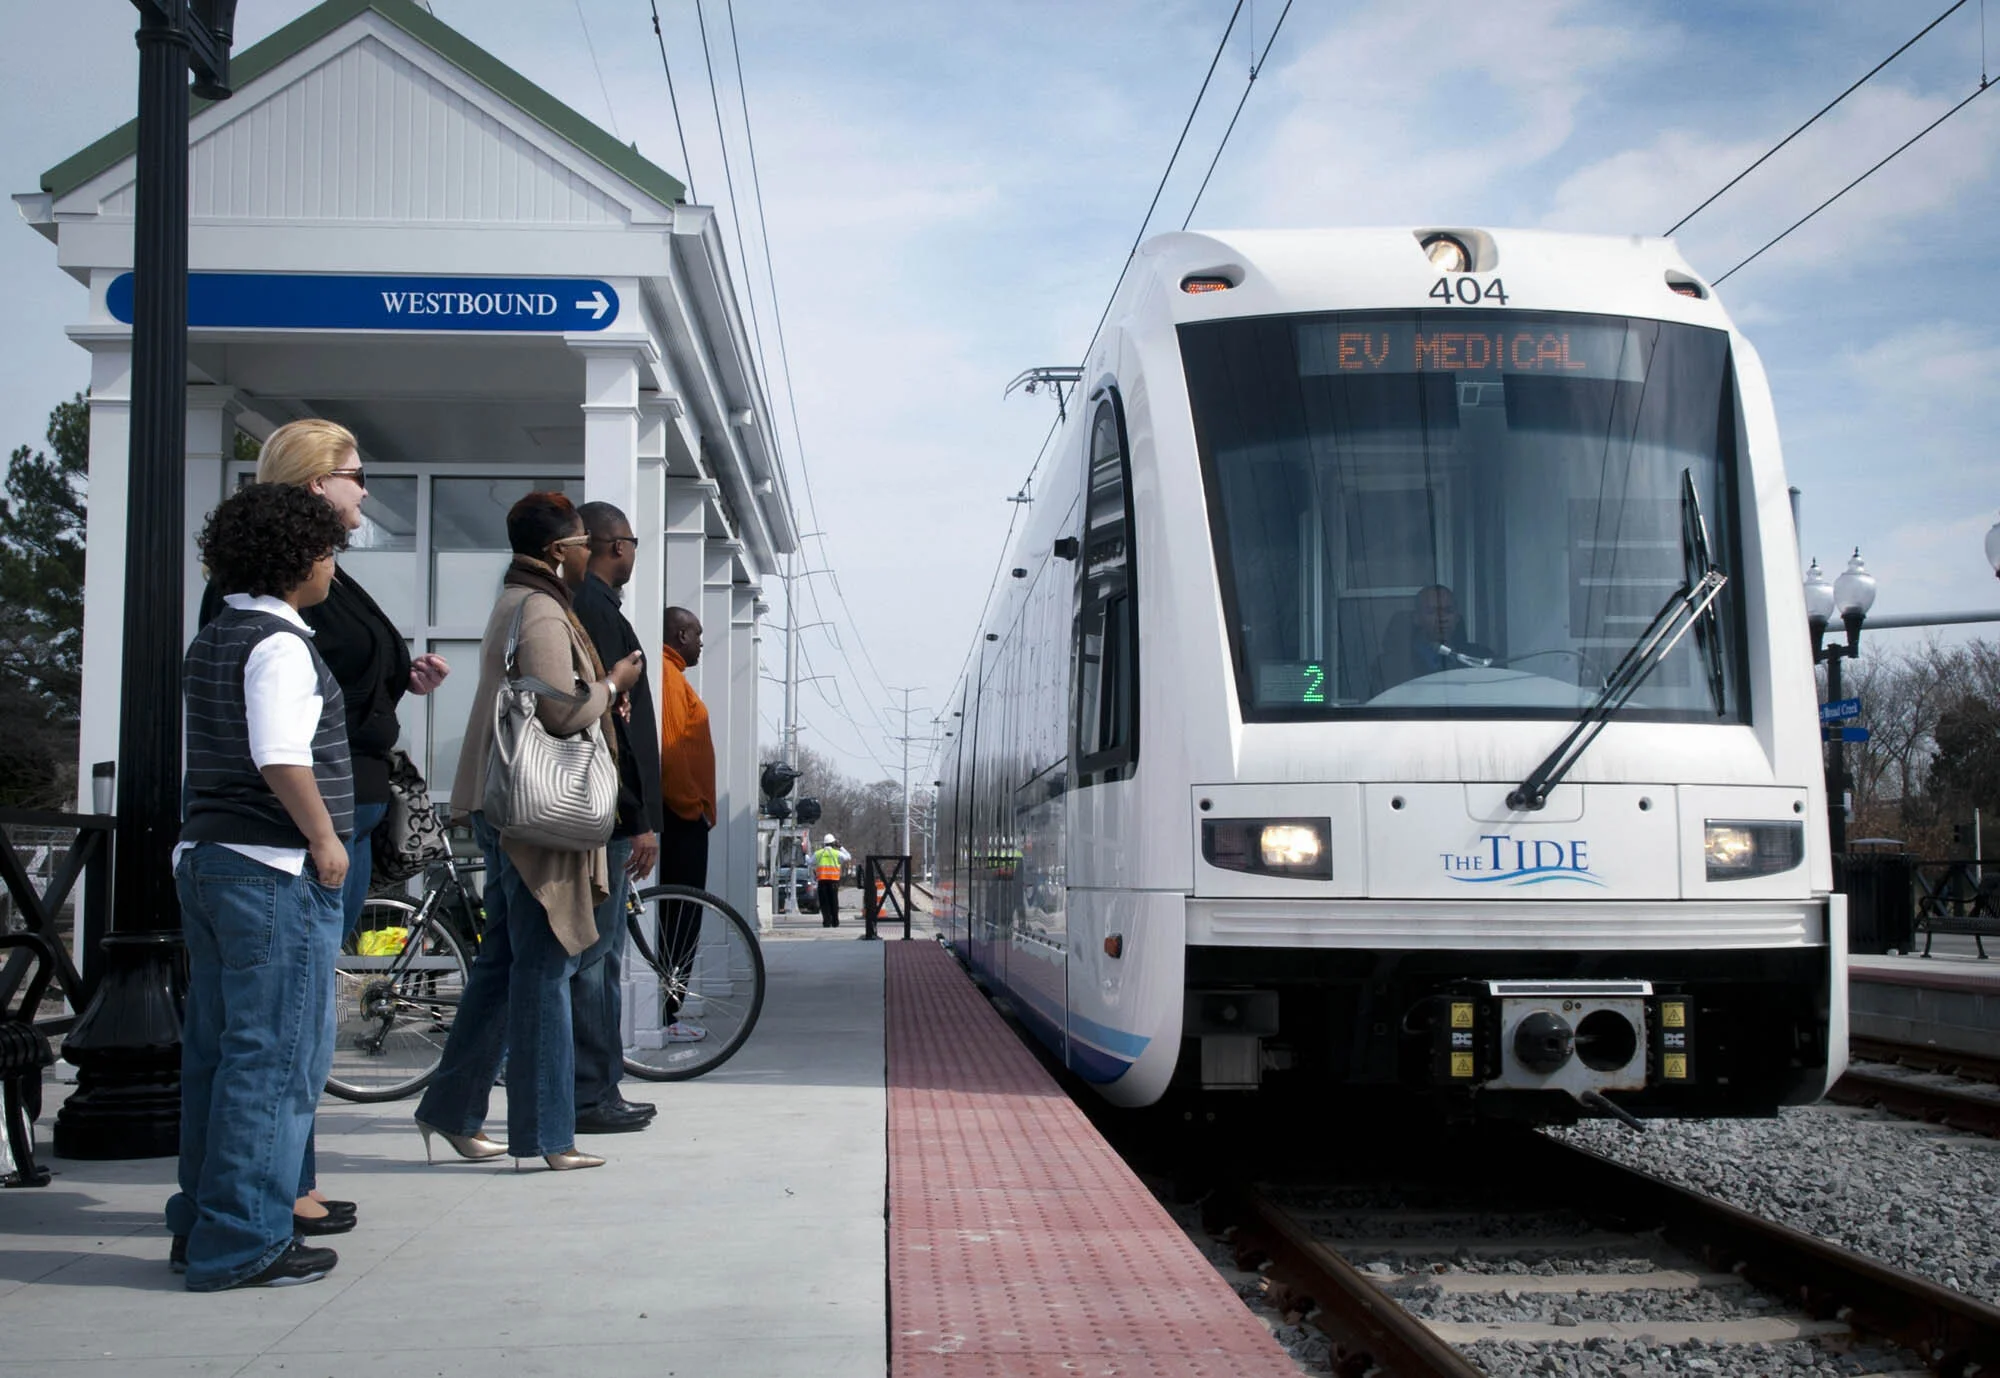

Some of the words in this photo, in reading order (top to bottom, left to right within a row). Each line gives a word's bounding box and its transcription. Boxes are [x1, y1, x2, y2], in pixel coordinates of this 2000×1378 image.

[381, 291, 558, 316] WESTBOUND
[1429, 277, 1510, 306] 404
[1338, 333, 1389, 369] EV
[1415, 333, 1586, 369] MEDICAL
[1303, 665, 1324, 702] 2
[1440, 853, 1483, 870] THE
[1479, 835, 1589, 871] TIDE
